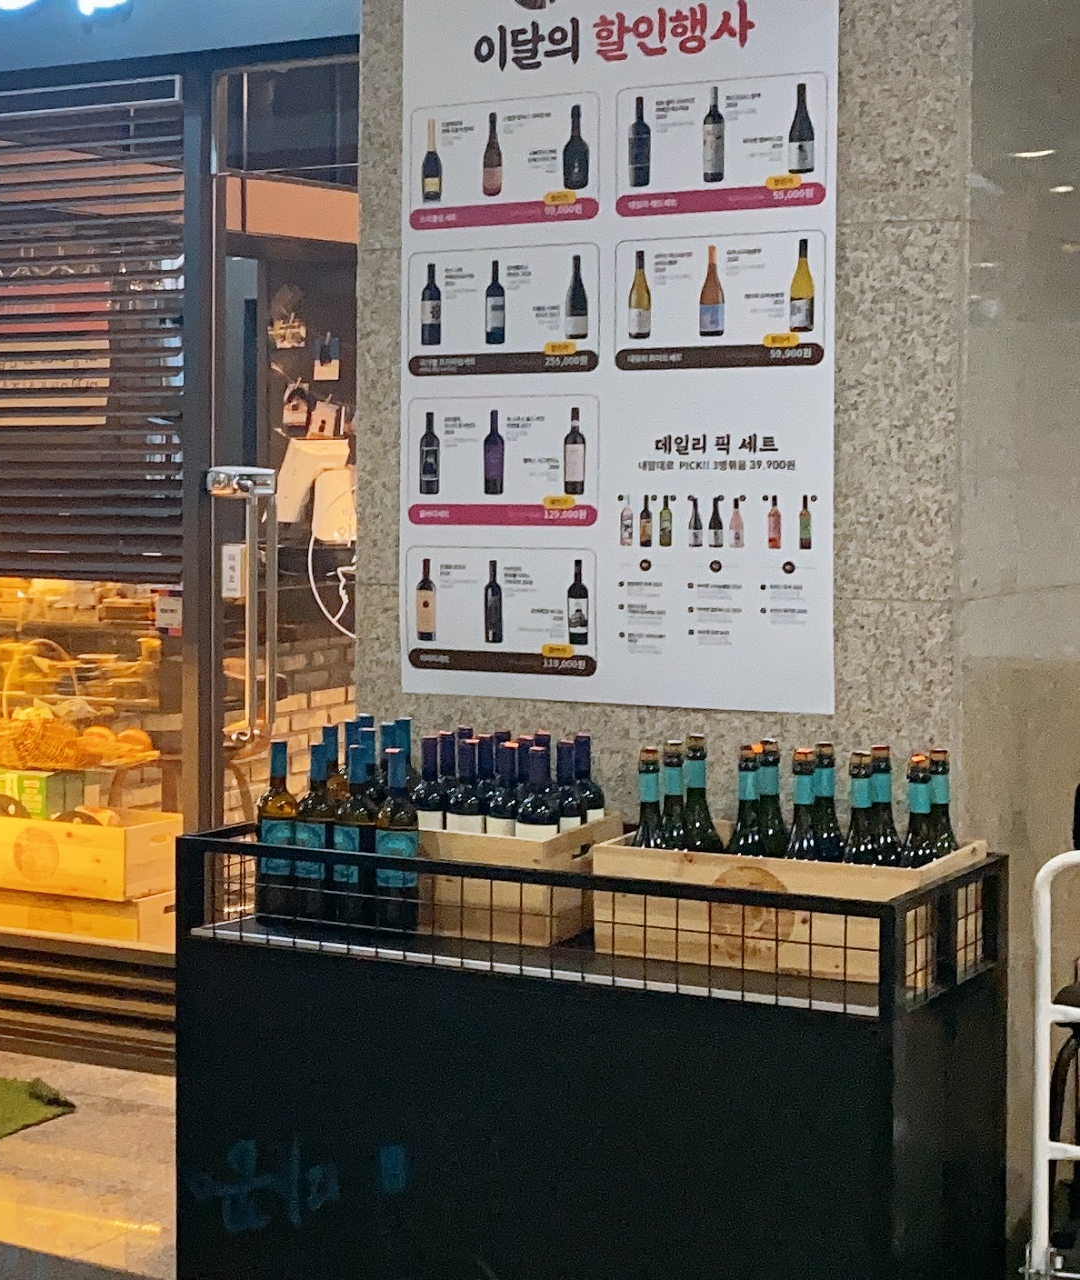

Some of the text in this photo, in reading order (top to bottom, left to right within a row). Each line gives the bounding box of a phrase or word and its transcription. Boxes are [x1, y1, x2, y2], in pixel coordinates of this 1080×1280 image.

[473, 16, 581, 71] 이달의
[654, 433, 779, 456] 데일리 픽 세트
